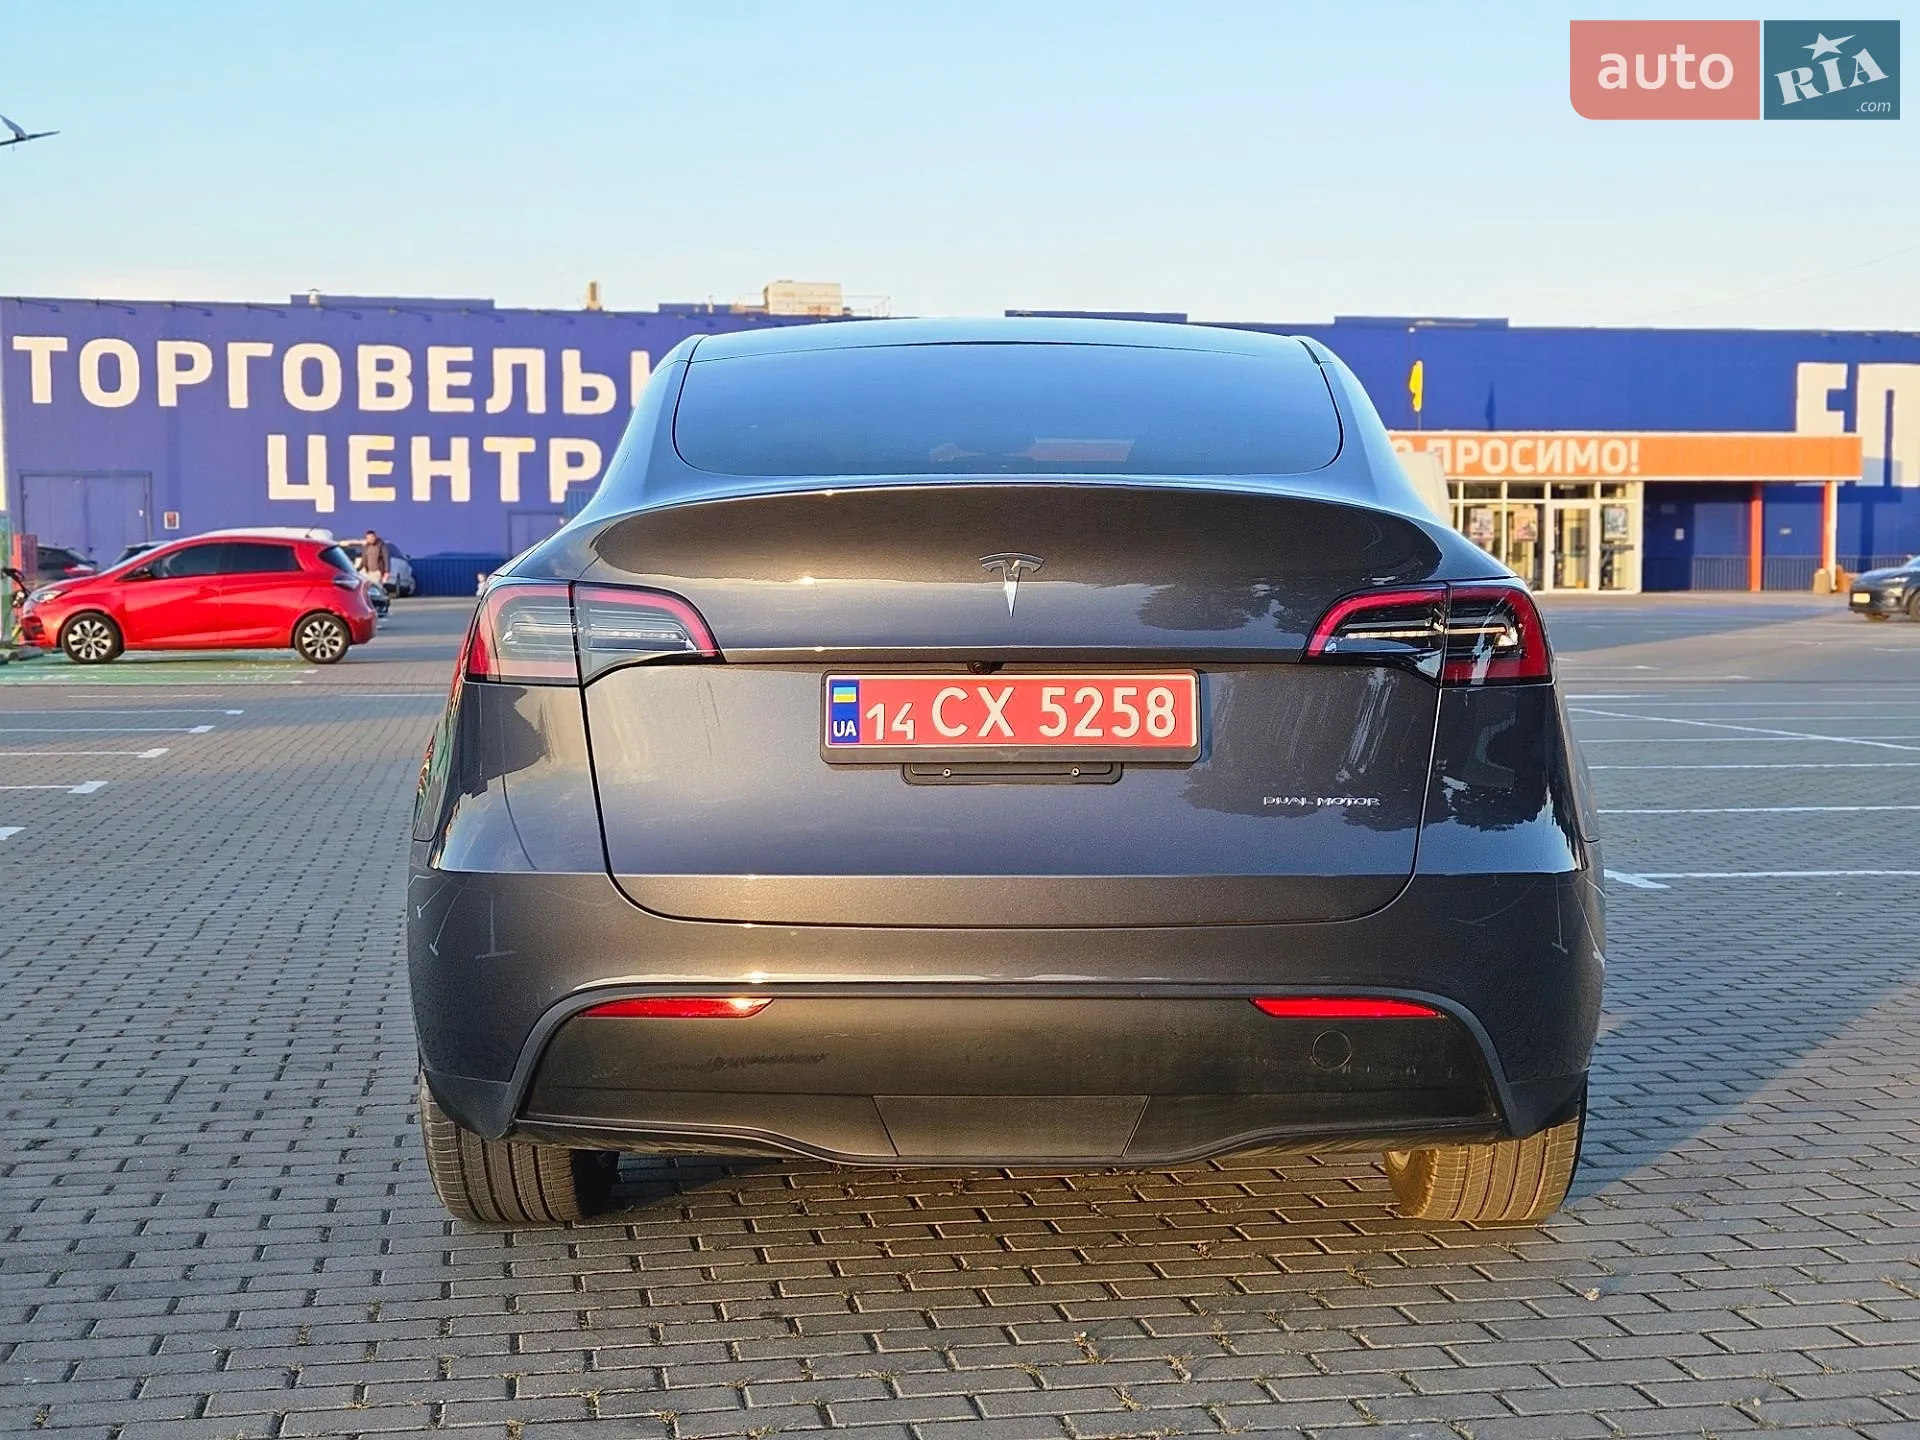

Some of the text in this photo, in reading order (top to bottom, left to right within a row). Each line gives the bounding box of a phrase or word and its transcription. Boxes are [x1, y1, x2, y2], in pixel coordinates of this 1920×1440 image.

[267, 434, 602, 512] ЦЕНТР
[1426, 438, 1640, 474] ПРОСИМО!
[832, 719, 857, 738] UA
[865, 686, 1177, 741] 14 CX 5258
[1263, 796, 1381, 807] DUAL MOTOR
